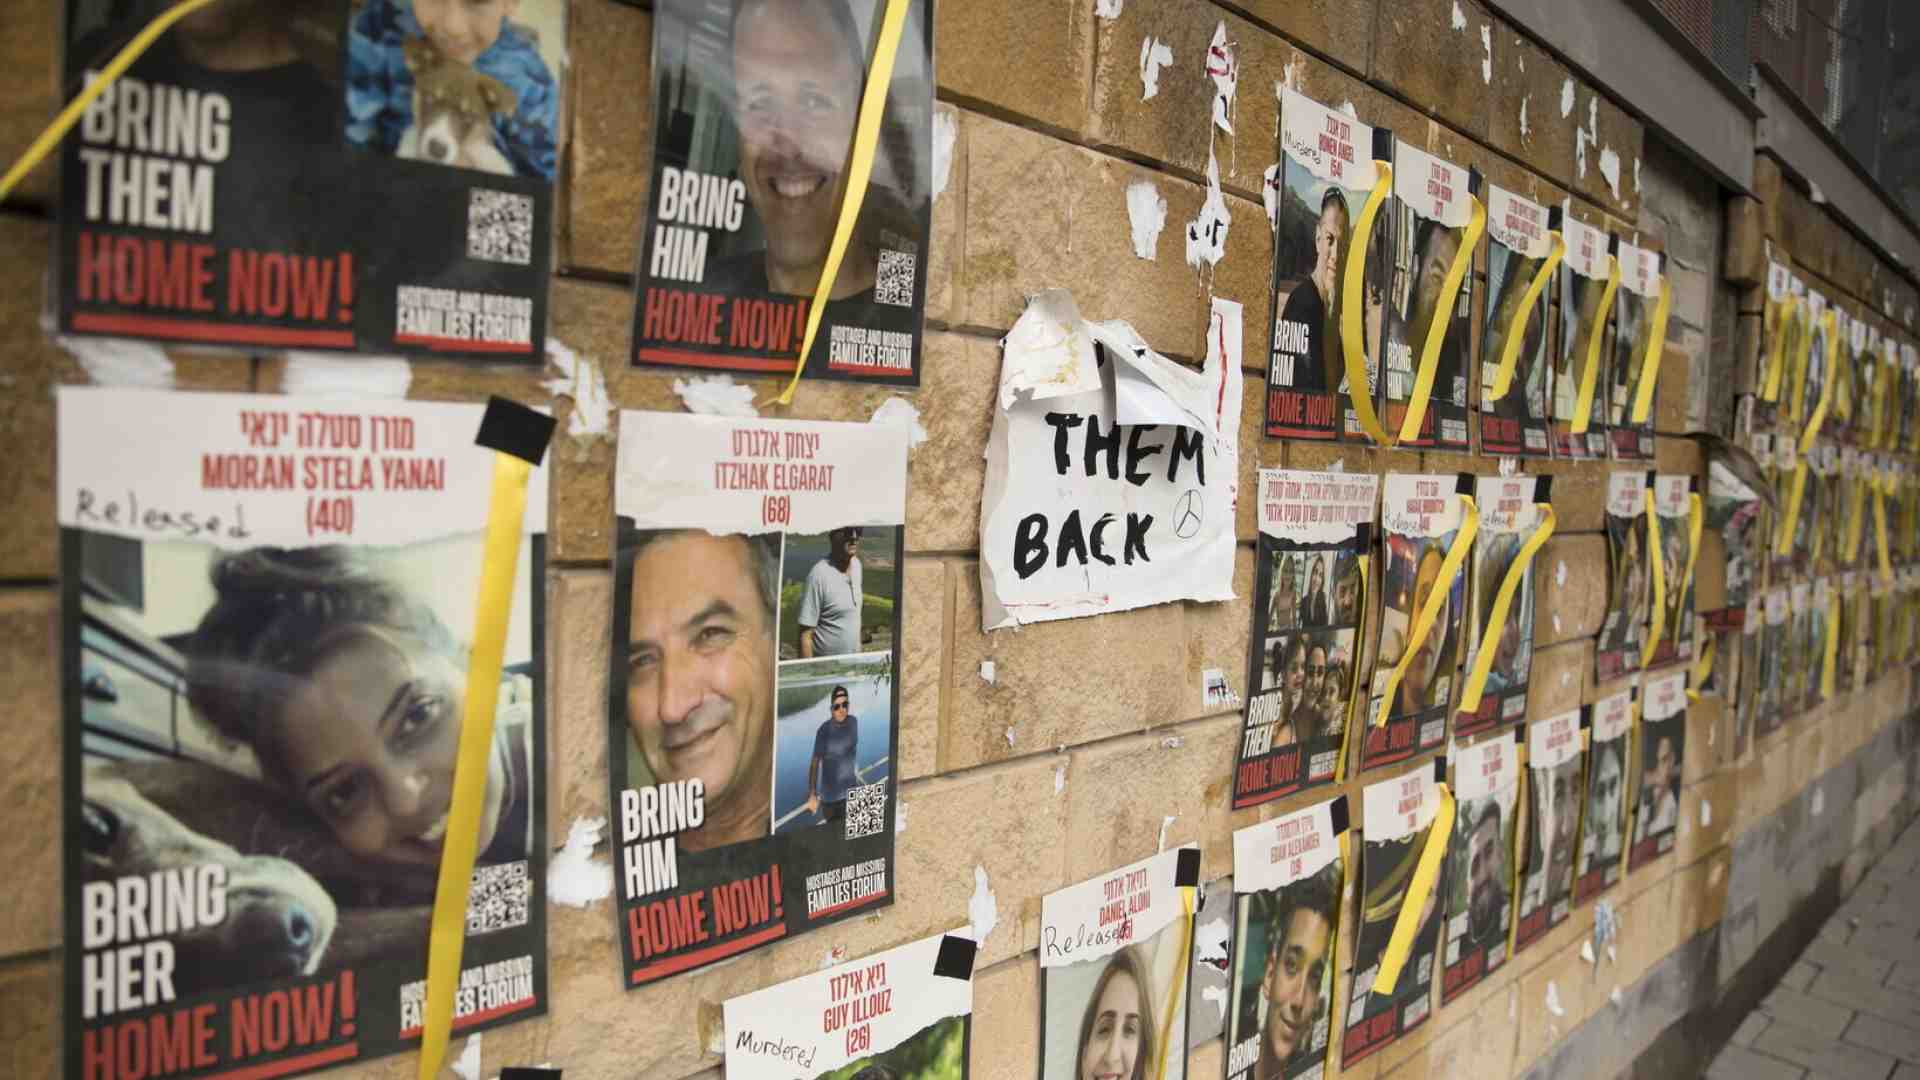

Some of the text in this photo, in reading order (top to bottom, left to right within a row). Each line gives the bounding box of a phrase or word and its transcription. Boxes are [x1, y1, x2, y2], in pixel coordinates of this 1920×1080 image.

[80, 69, 231, 163] BRING
[80, 150, 215, 235] THEM
[657, 166, 746, 232] BRING
[650, 226, 709, 283] HIM
[76, 232, 354, 323] HOME NOW!
[643, 288, 809, 353] HOME NOW!
[1274, 318, 1309, 354] BRING
[829, 341, 912, 369] FAMILIES FORUM
[1271, 352, 1295, 386] HIM
[240, 409, 416, 451] מורן סטלה ינאי
[1269, 390, 1305, 424] HOME
[1306, 394, 1337, 427] NOW!
[732, 428, 820, 461] יצחק אלגרט
[1044, 411, 1206, 488] THEM
[201, 454, 446, 491] MORAN STELA YANAI
[714, 461, 835, 492] ITZHAK ELGARAT
[74, 488, 251, 540] Released
[305, 494, 354, 537] (40)
[761, 495, 791, 527] (68)
[1013, 508, 1155, 581] BACK
[1247, 691, 1283, 727] BRING
[1243, 724, 1276, 759] THEM
[1238, 757, 1273, 793] HOME
[621, 777, 704, 844] BRING
[624, 837, 679, 900] HIM
[806, 869, 841, 893] HOSTAGES
[83, 863, 228, 950] BRING
[628, 863, 784, 960] HOME NOW!
[807, 871, 886, 913] FAMILIES FORUM
[1044, 911, 1127, 957] Released
[83, 941, 176, 1019] HER
[867, 962, 886, 990] גיא
[400, 987, 476, 1030] FAES
[478, 974, 534, 1012] FORUM
[823, 988, 892, 1033] GUY ILLOUZ
[83, 970, 356, 1080] HOME NOW!
[845, 1023, 871, 1057] (26)
[736, 1030, 817, 1069] Murdered
